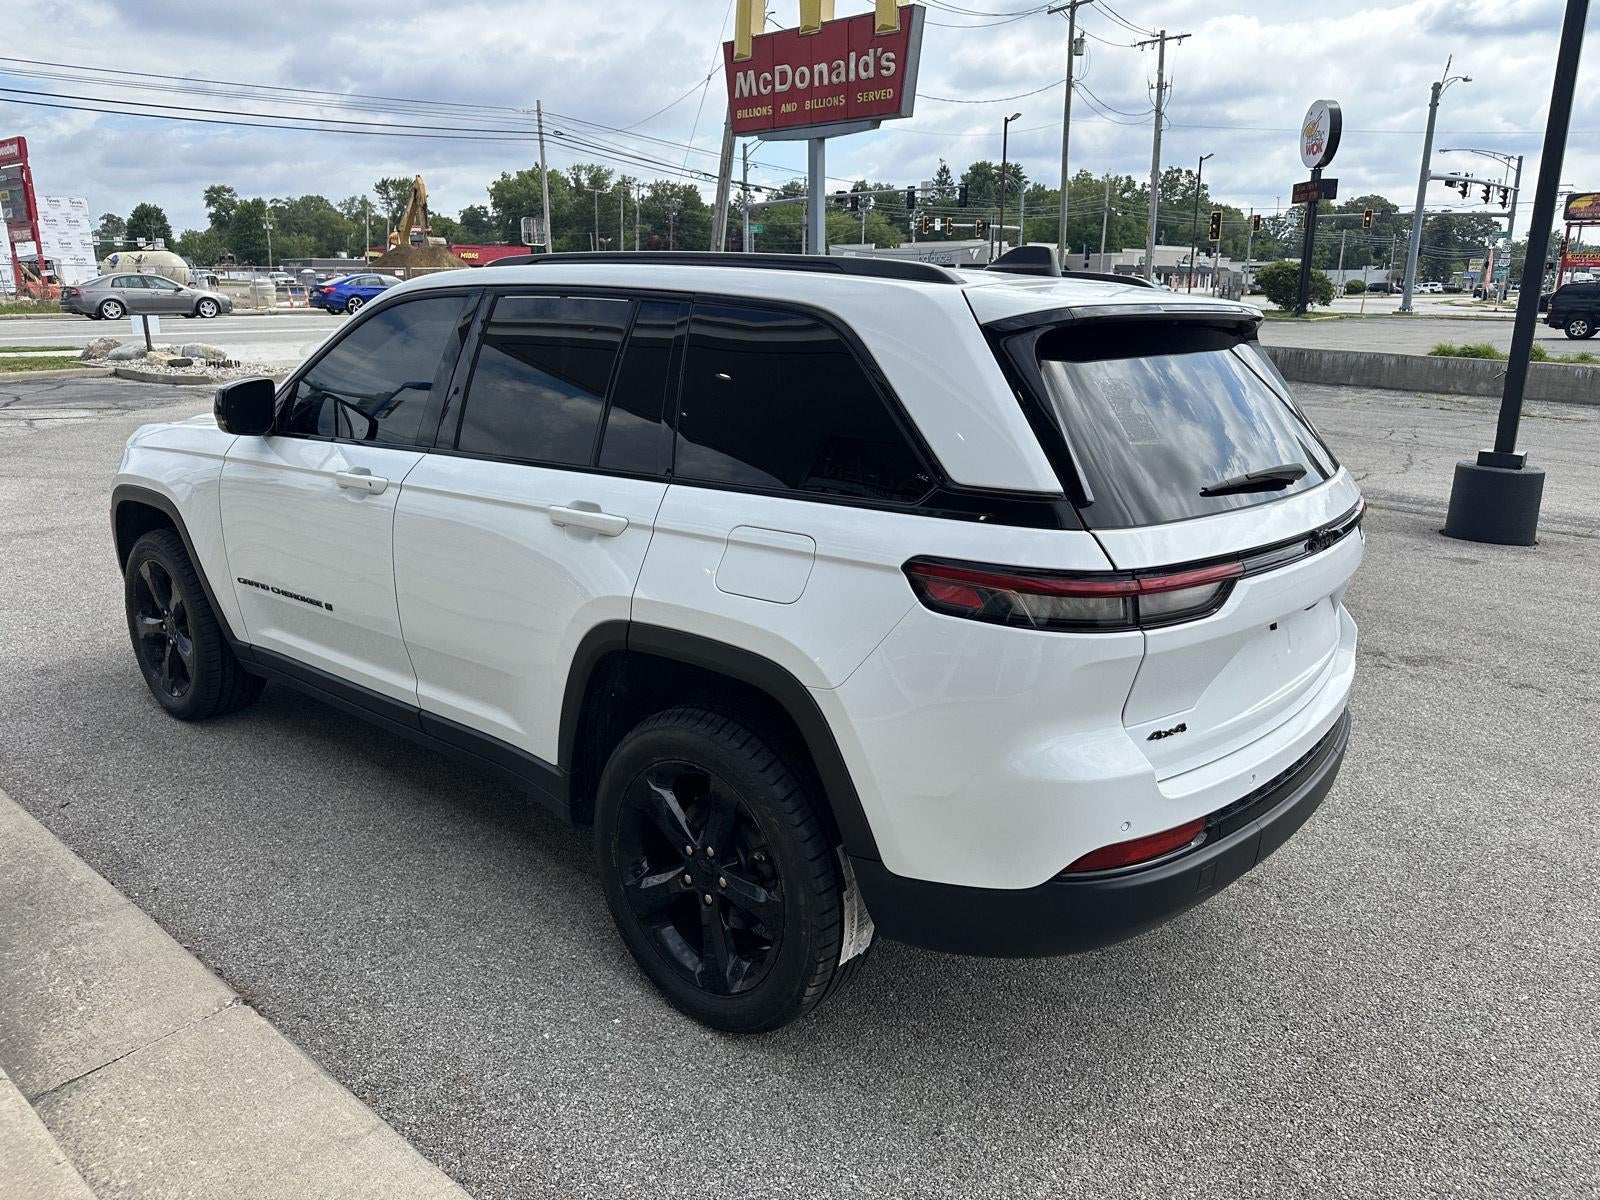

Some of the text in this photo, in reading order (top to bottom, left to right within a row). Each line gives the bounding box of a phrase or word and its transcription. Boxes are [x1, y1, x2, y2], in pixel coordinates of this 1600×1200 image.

[734, 48, 897, 99] McDonald's
[736, 88, 894, 119] BILLIONS AND BILLIONS SERVED
[237, 577, 324, 608] GRAND CHEROKEE
[1146, 722, 1187, 741] 4x4
